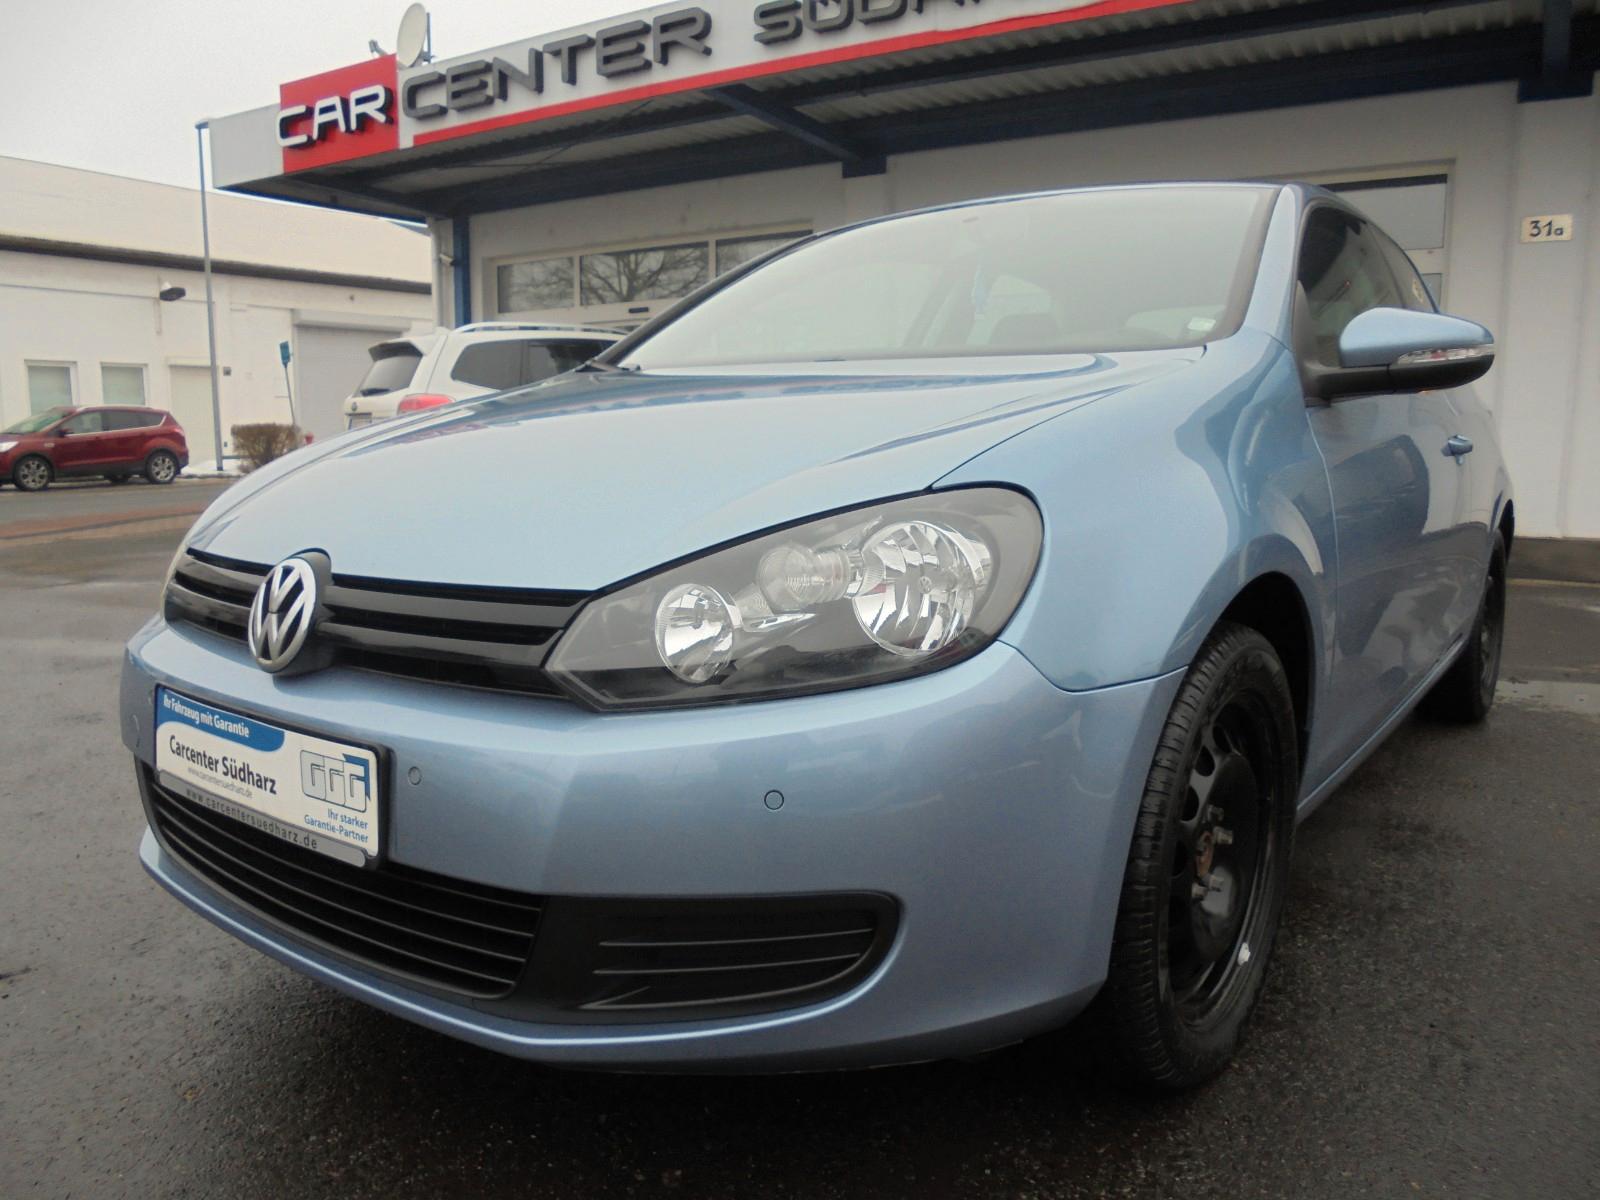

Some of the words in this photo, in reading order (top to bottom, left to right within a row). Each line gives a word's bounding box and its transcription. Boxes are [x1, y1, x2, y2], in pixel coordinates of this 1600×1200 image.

[275, 84, 393, 149] CAR
[402, 6, 712, 120] CENTER
[1529, 219, 1564, 237] 31a
[171, 698, 200, 724] Fahrzeug
[200, 711, 213, 726] mit
[213, 715, 250, 738] Garantie
[169, 734, 220, 774] Carcenter
[221, 756, 277, 795] Südharz
[304, 814, 369, 843] Garantie-Partner
[327, 808, 339, 820] Ihr
[340, 814, 369, 829] starker
